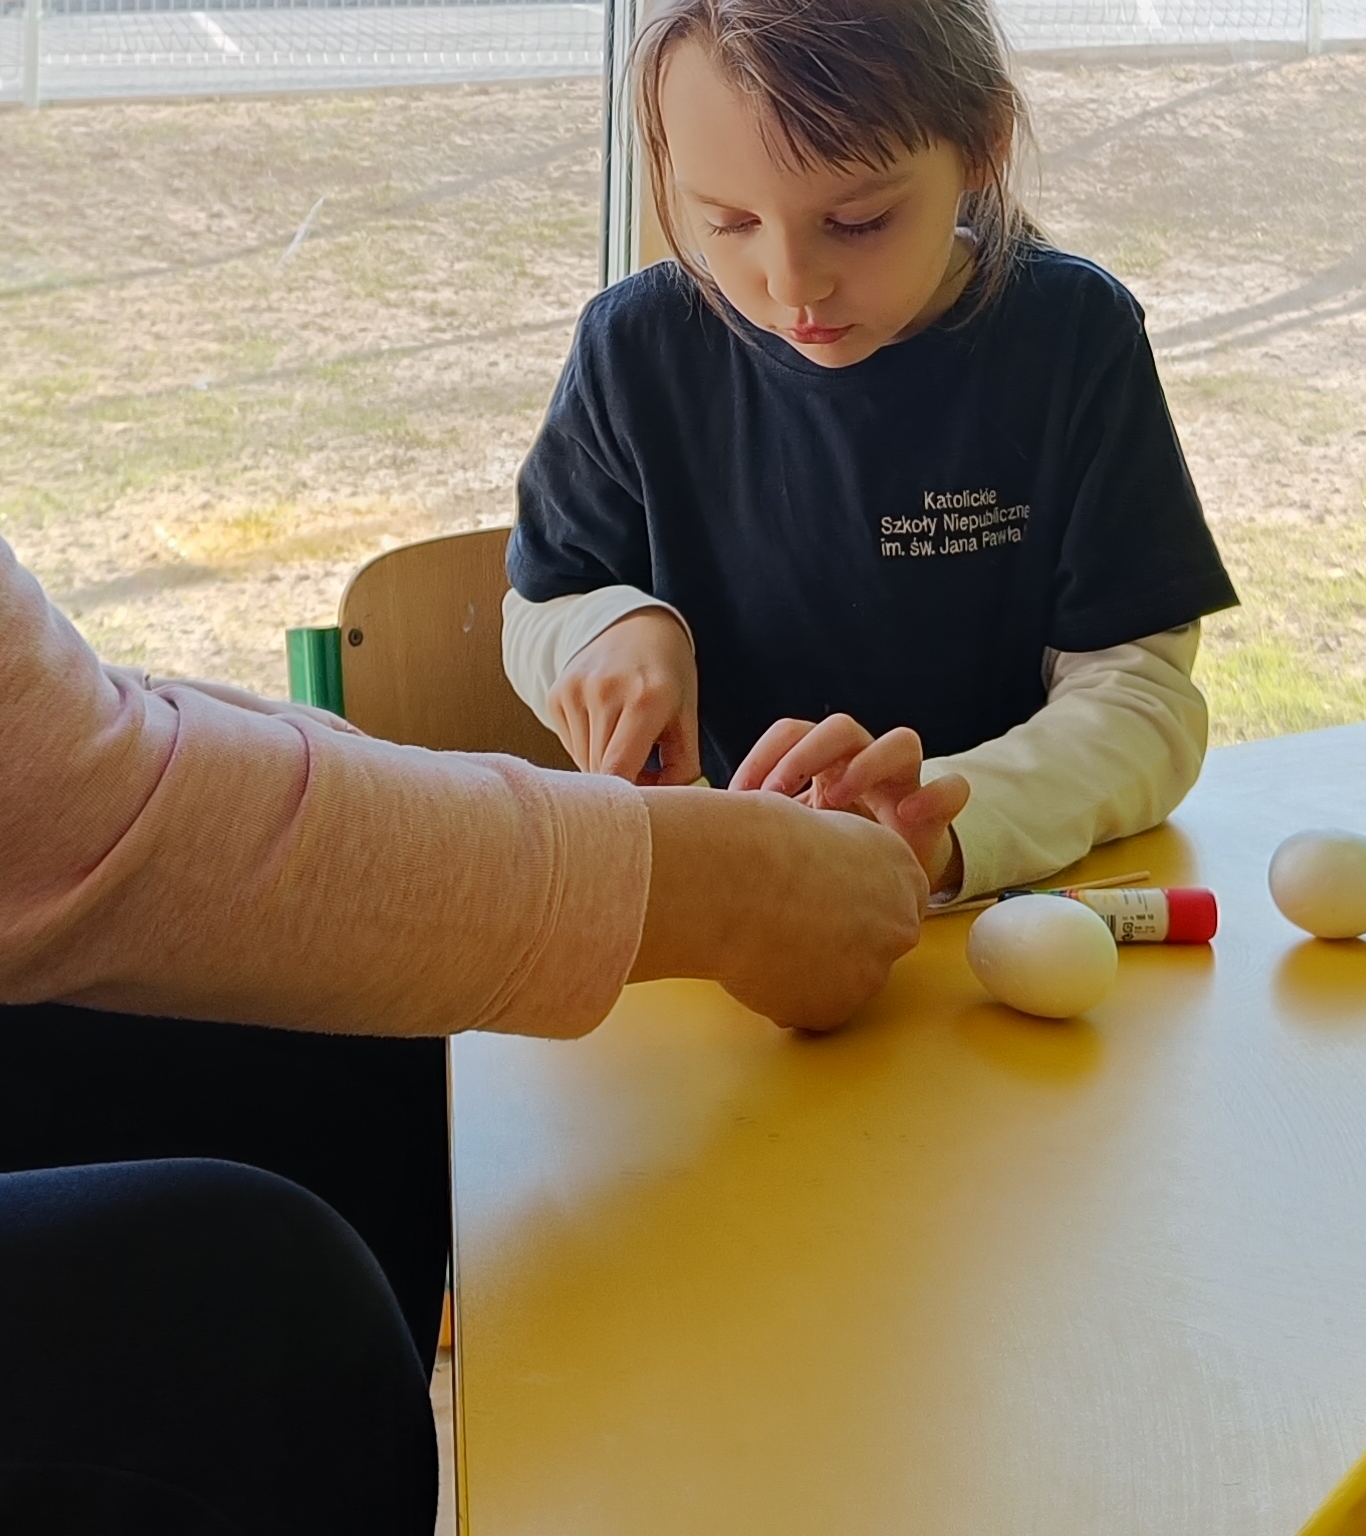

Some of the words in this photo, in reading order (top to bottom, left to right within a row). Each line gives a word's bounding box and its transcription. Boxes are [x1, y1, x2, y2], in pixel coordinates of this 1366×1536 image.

[923, 488, 996, 510] Katolickie
[881, 515, 937, 536] Szkoły
[943, 505, 1031, 534] Niepubliczne
[880, 537, 905, 556] im.
[910, 537, 935, 556] św.
[939, 536, 978, 554] Jana
